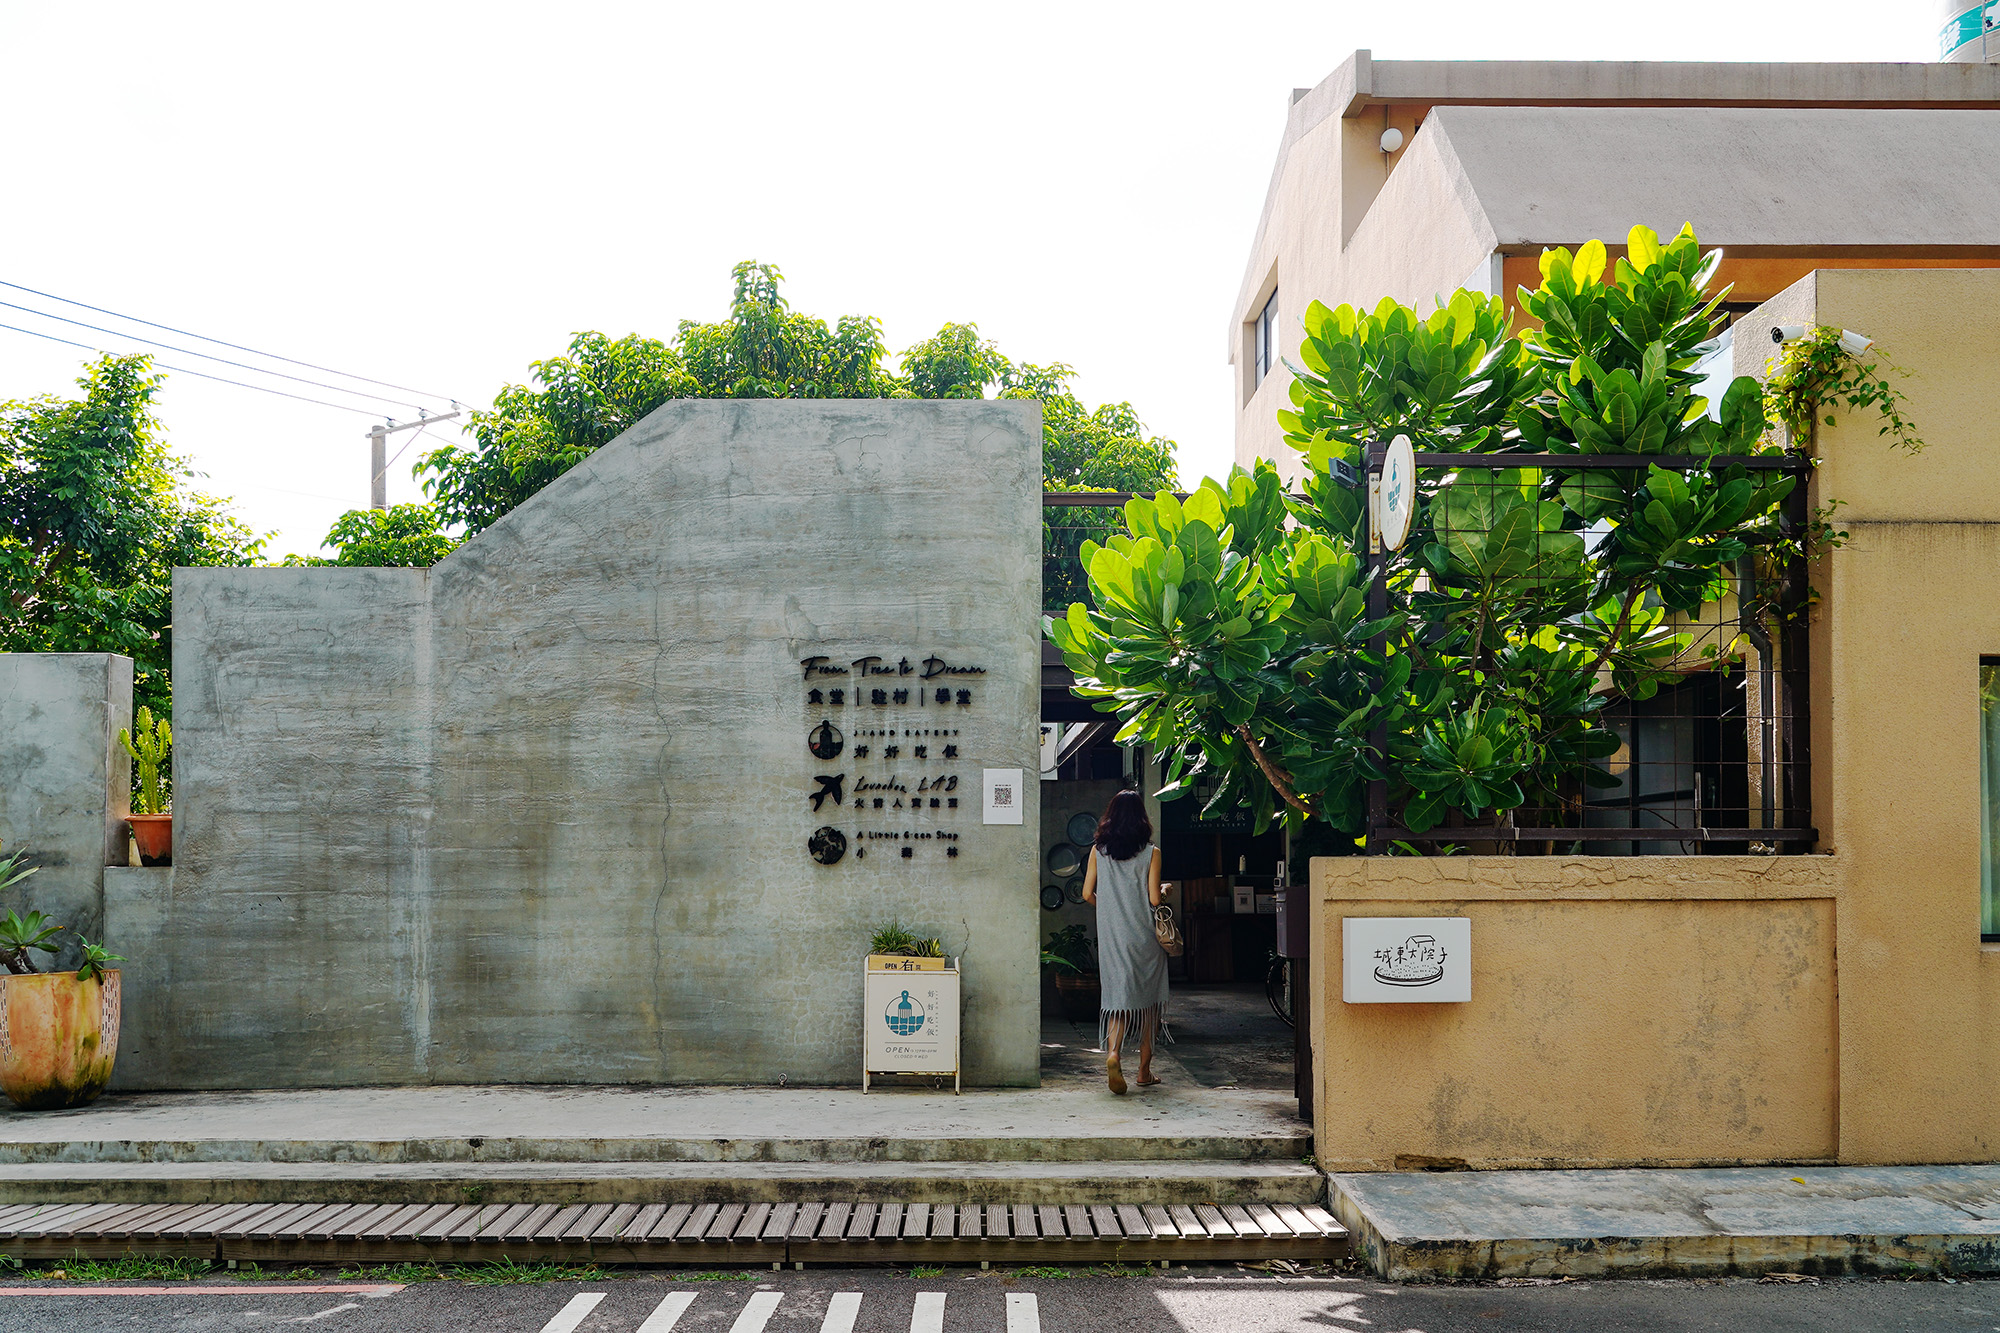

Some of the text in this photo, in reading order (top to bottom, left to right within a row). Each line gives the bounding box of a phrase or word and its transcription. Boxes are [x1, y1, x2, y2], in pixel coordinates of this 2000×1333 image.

[800, 654, 986, 680] From Tree to Dream
[808, 688, 844, 705] 食堂
[935, 688, 971, 705] 學堂
[917, 775, 958, 793] LAB
[856, 831, 958, 842] A Little Geen Shop
[885, 1046, 910, 1054] OPEN
